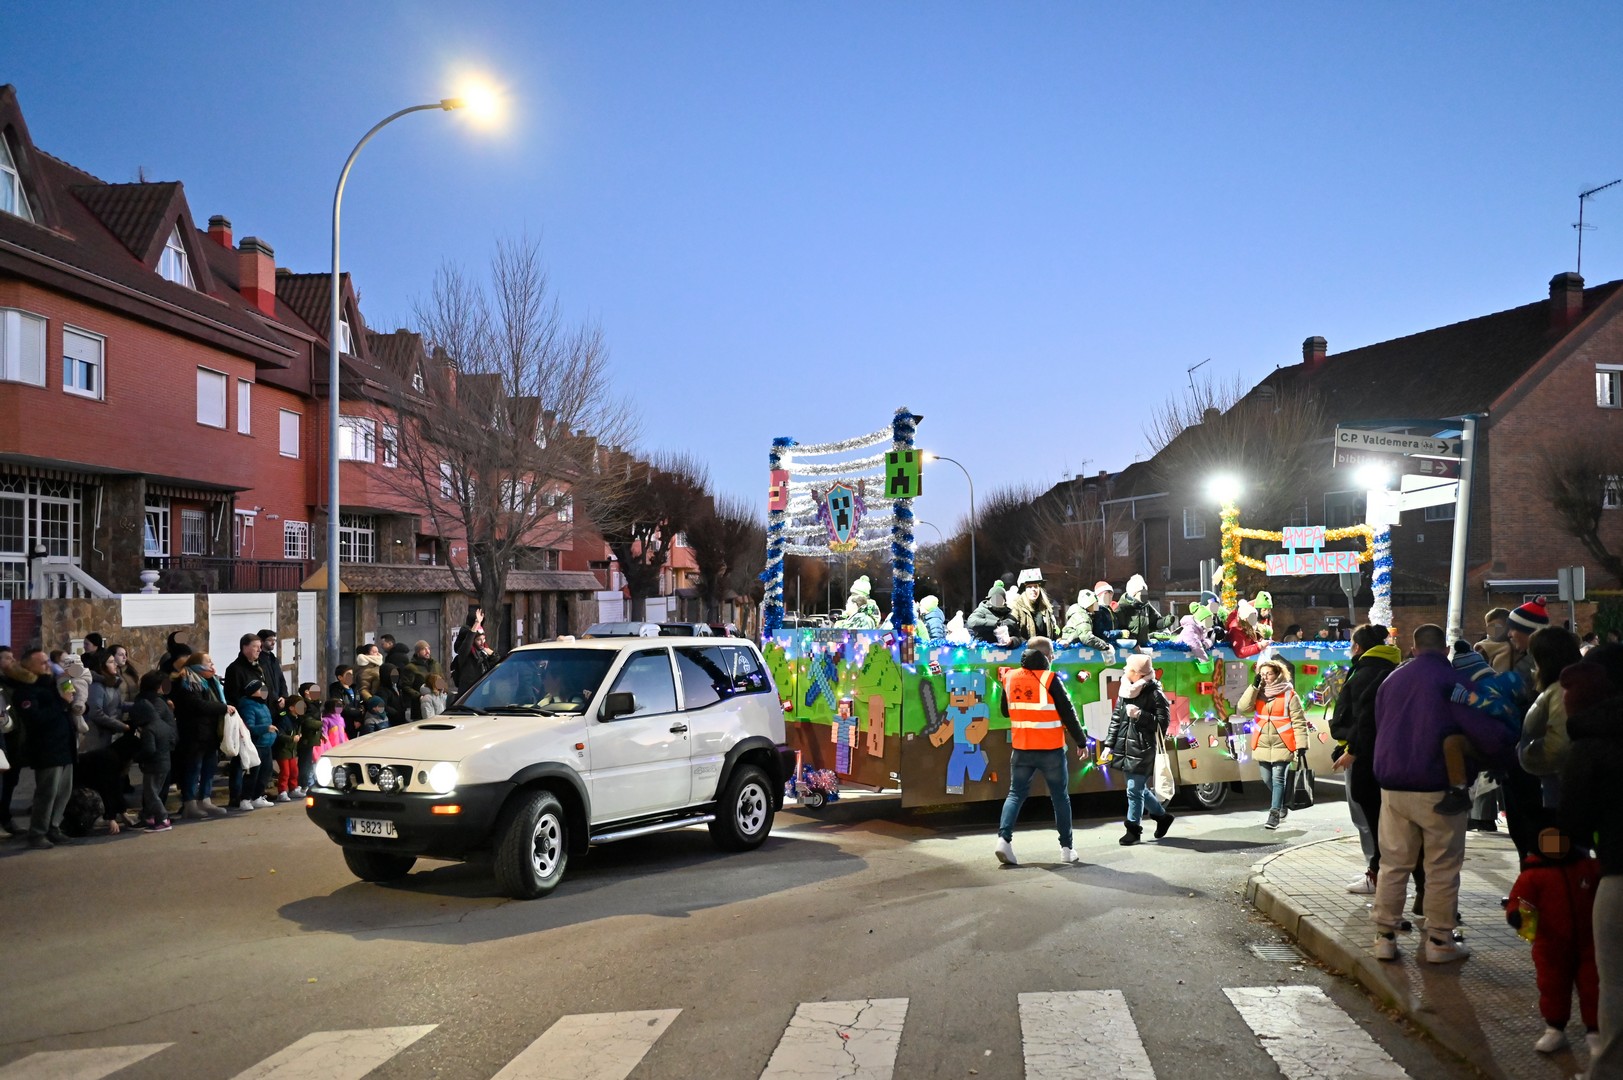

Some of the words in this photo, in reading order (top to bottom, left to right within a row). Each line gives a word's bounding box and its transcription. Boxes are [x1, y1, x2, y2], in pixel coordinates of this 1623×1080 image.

[1340, 432, 1358, 443] C.P.
[1362, 434, 1419, 449] Valdemera
[1338, 454, 1398, 468] biblioa
[1283, 526, 1324, 548] AMPA
[1266, 551, 1360, 575] VALDEMERA
[361, 820, 382, 835] 5823
